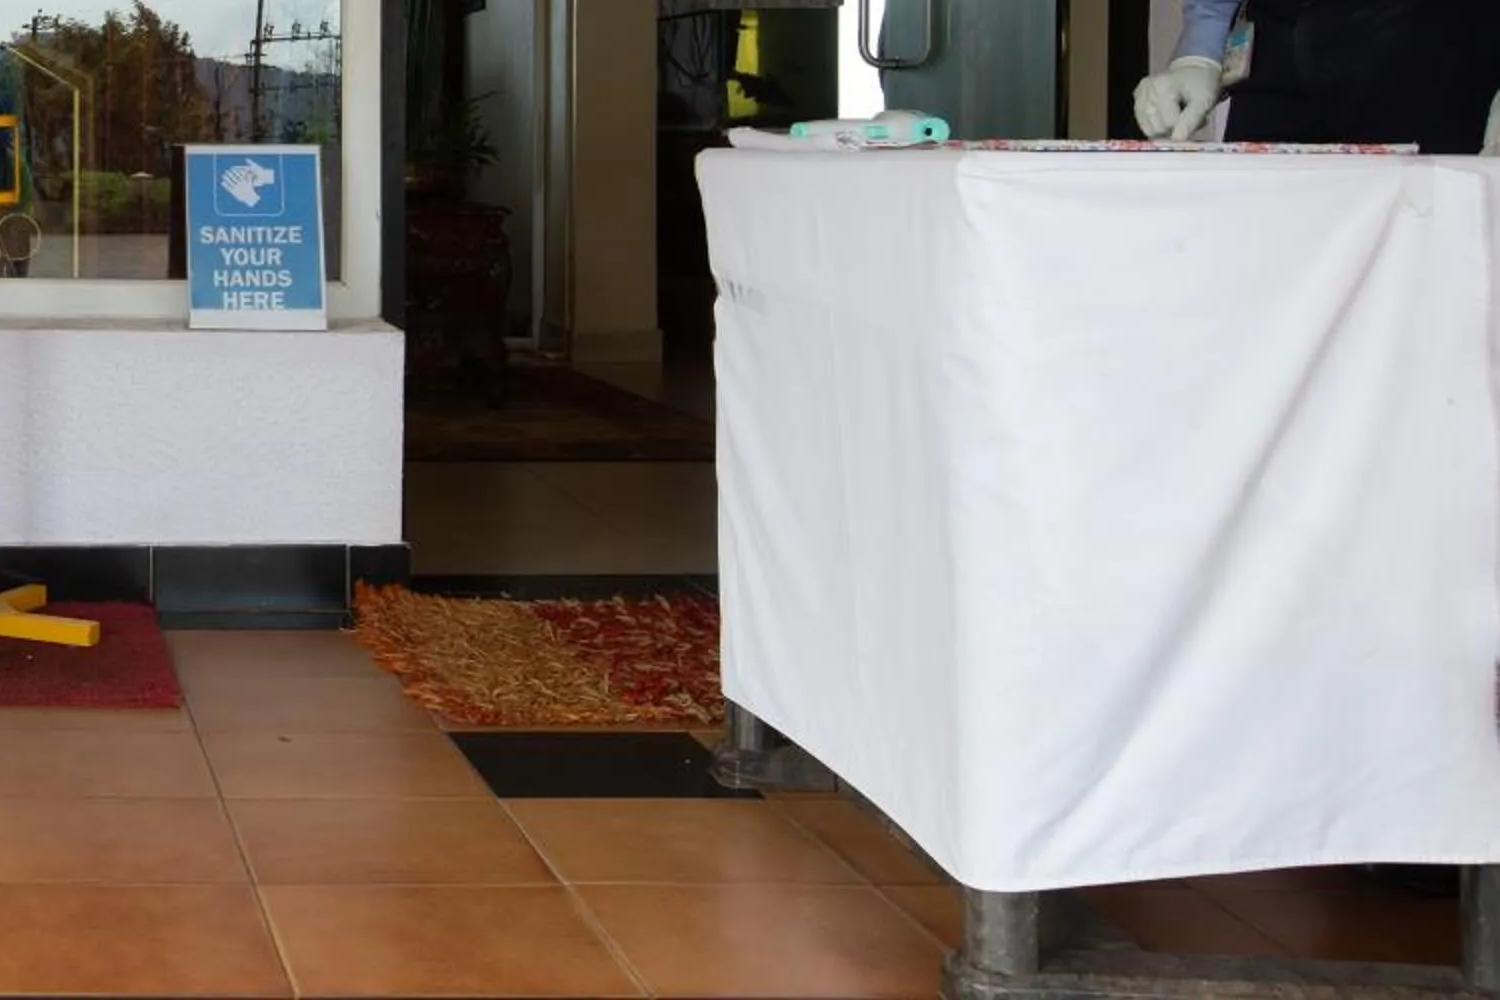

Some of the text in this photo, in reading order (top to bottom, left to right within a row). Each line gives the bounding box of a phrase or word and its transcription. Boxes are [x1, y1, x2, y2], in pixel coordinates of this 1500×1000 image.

[200, 225, 303, 245] SANITIZE
[220, 247, 283, 266] YOUR
[213, 269, 293, 288] HANDS
[222, 290, 285, 311] HERE
